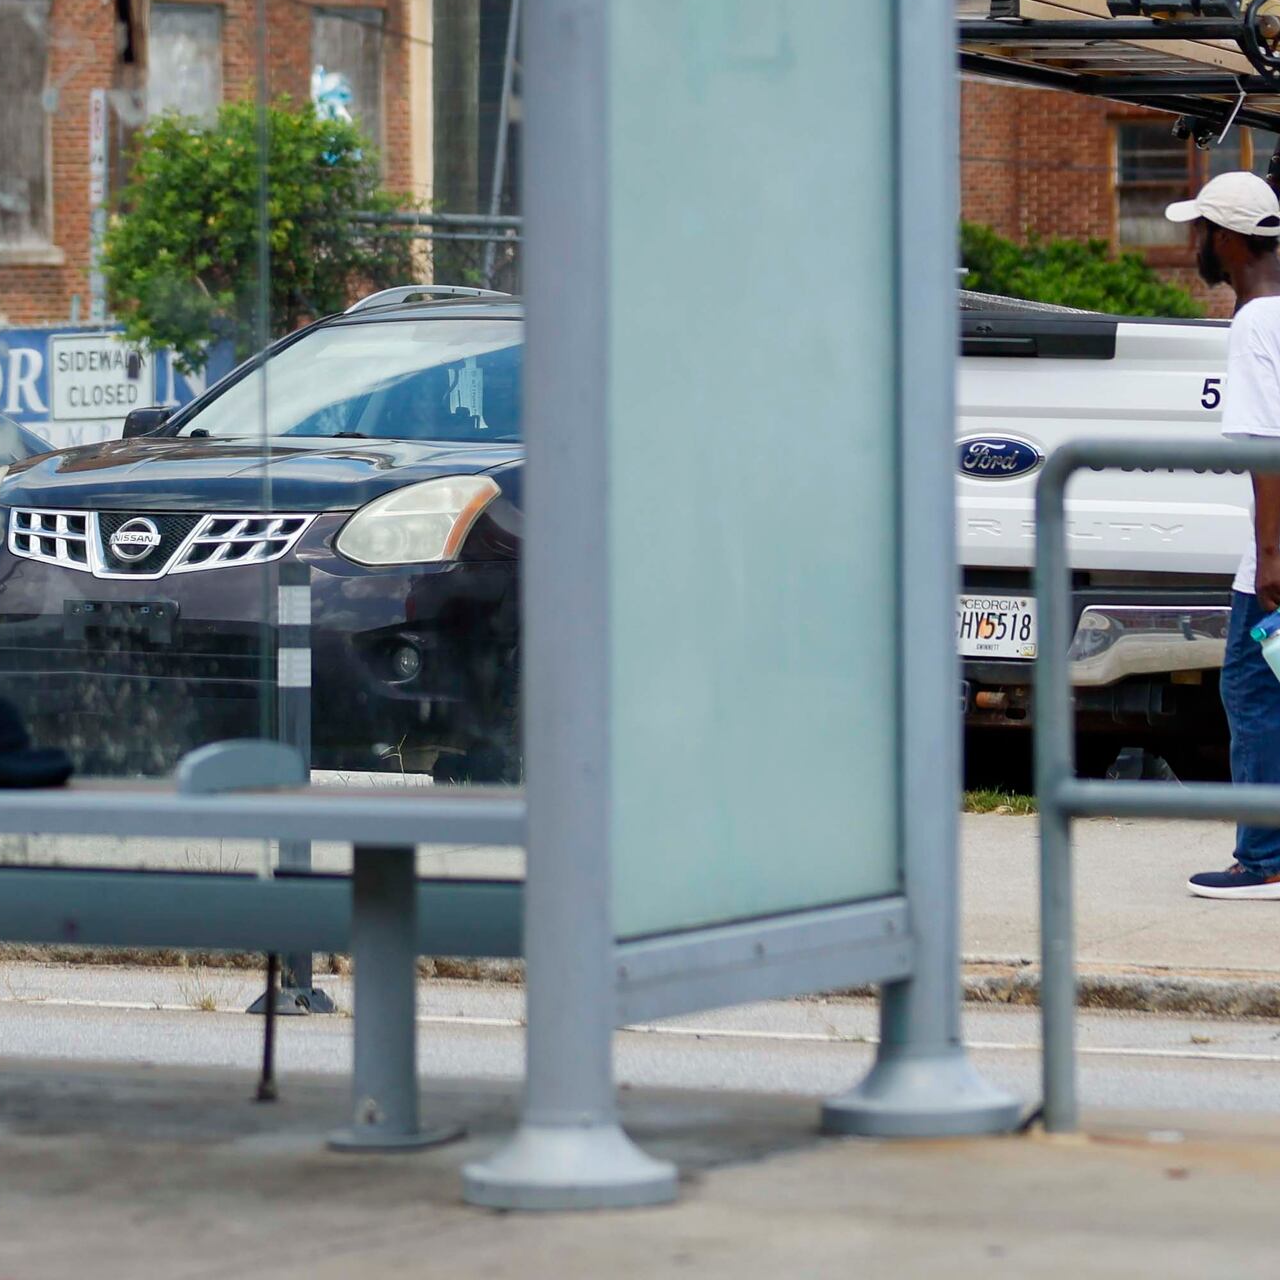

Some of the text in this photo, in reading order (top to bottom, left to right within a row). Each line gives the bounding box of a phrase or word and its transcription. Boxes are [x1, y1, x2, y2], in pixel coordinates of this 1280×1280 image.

[69, 384, 138, 407] CLOSED
[964, 442, 1019, 470] Ford
[113, 534, 153, 543] NISSAN
[965, 598, 1020, 612] GEORGIA
[958, 611, 1032, 642] HY5518
